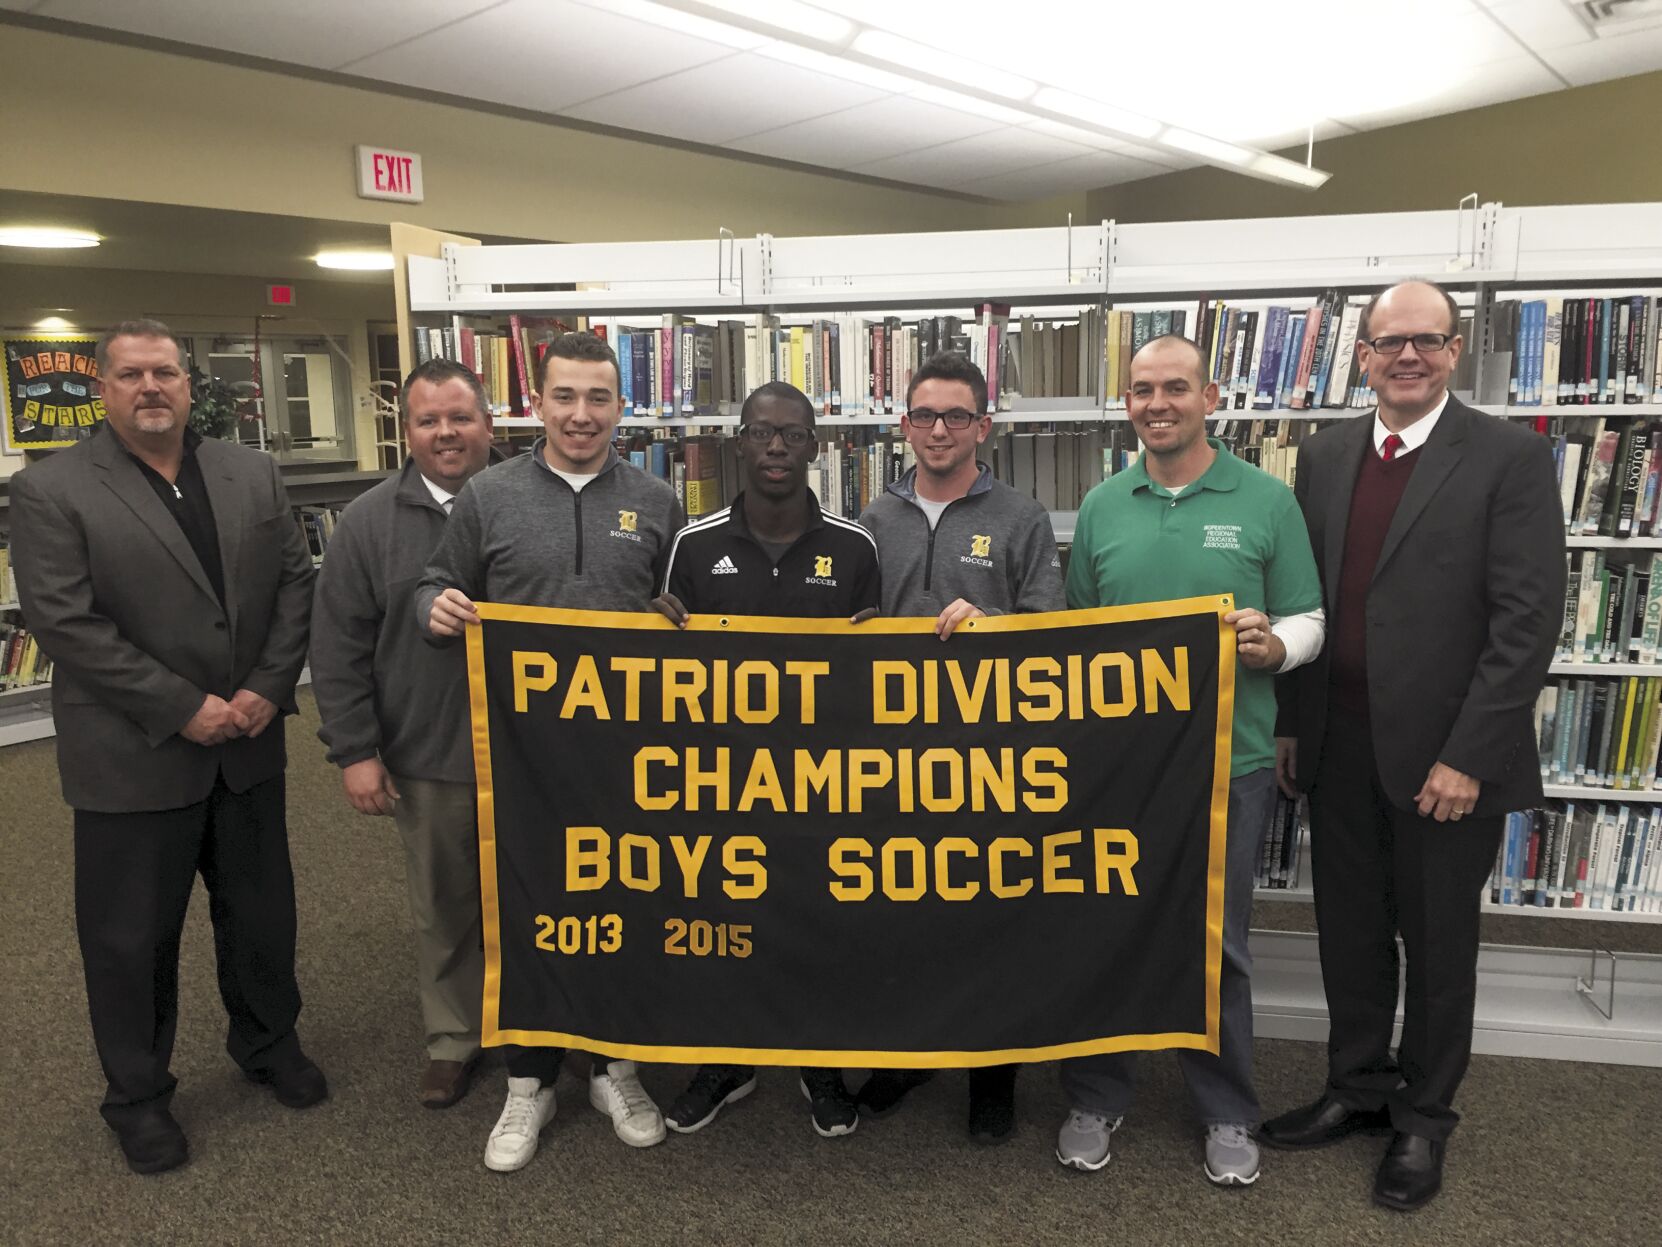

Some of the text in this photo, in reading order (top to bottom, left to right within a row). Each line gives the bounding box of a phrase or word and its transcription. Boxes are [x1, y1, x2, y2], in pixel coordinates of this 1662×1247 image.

[373, 153, 412, 193] EXIT
[1321, 302, 1331, 326] PHYSICS
[1314, 348, 1323, 362] 20TH
[1317, 337, 1325, 346] THE
[1339, 320, 1357, 370] PHYSICS
[1618, 334, 1627, 371] STORM
[25, 353, 99, 377] REACH
[27, 402, 108, 425] STARS
[1628, 436, 1647, 493] BIOLOGY
[610, 530, 641, 543] SOCCER
[960, 556, 993, 567] SOCCER
[805, 577, 837, 586] SOCCER
[1647, 602, 1660, 619] OF
[1643, 622, 1657, 644] LIFE
[511, 645, 1191, 725] PATRIOT DIVISION
[633, 745, 1069, 814] CHAMPIONS
[1562, 822, 1572, 855] Introduction
[1590, 822, 1602, 869] Temperate Forest
[1613, 824, 1625, 863] Tropical Forest
[565, 826, 1140, 902] BOYS SOCCER
[534, 913, 753, 959] 2013 2015
